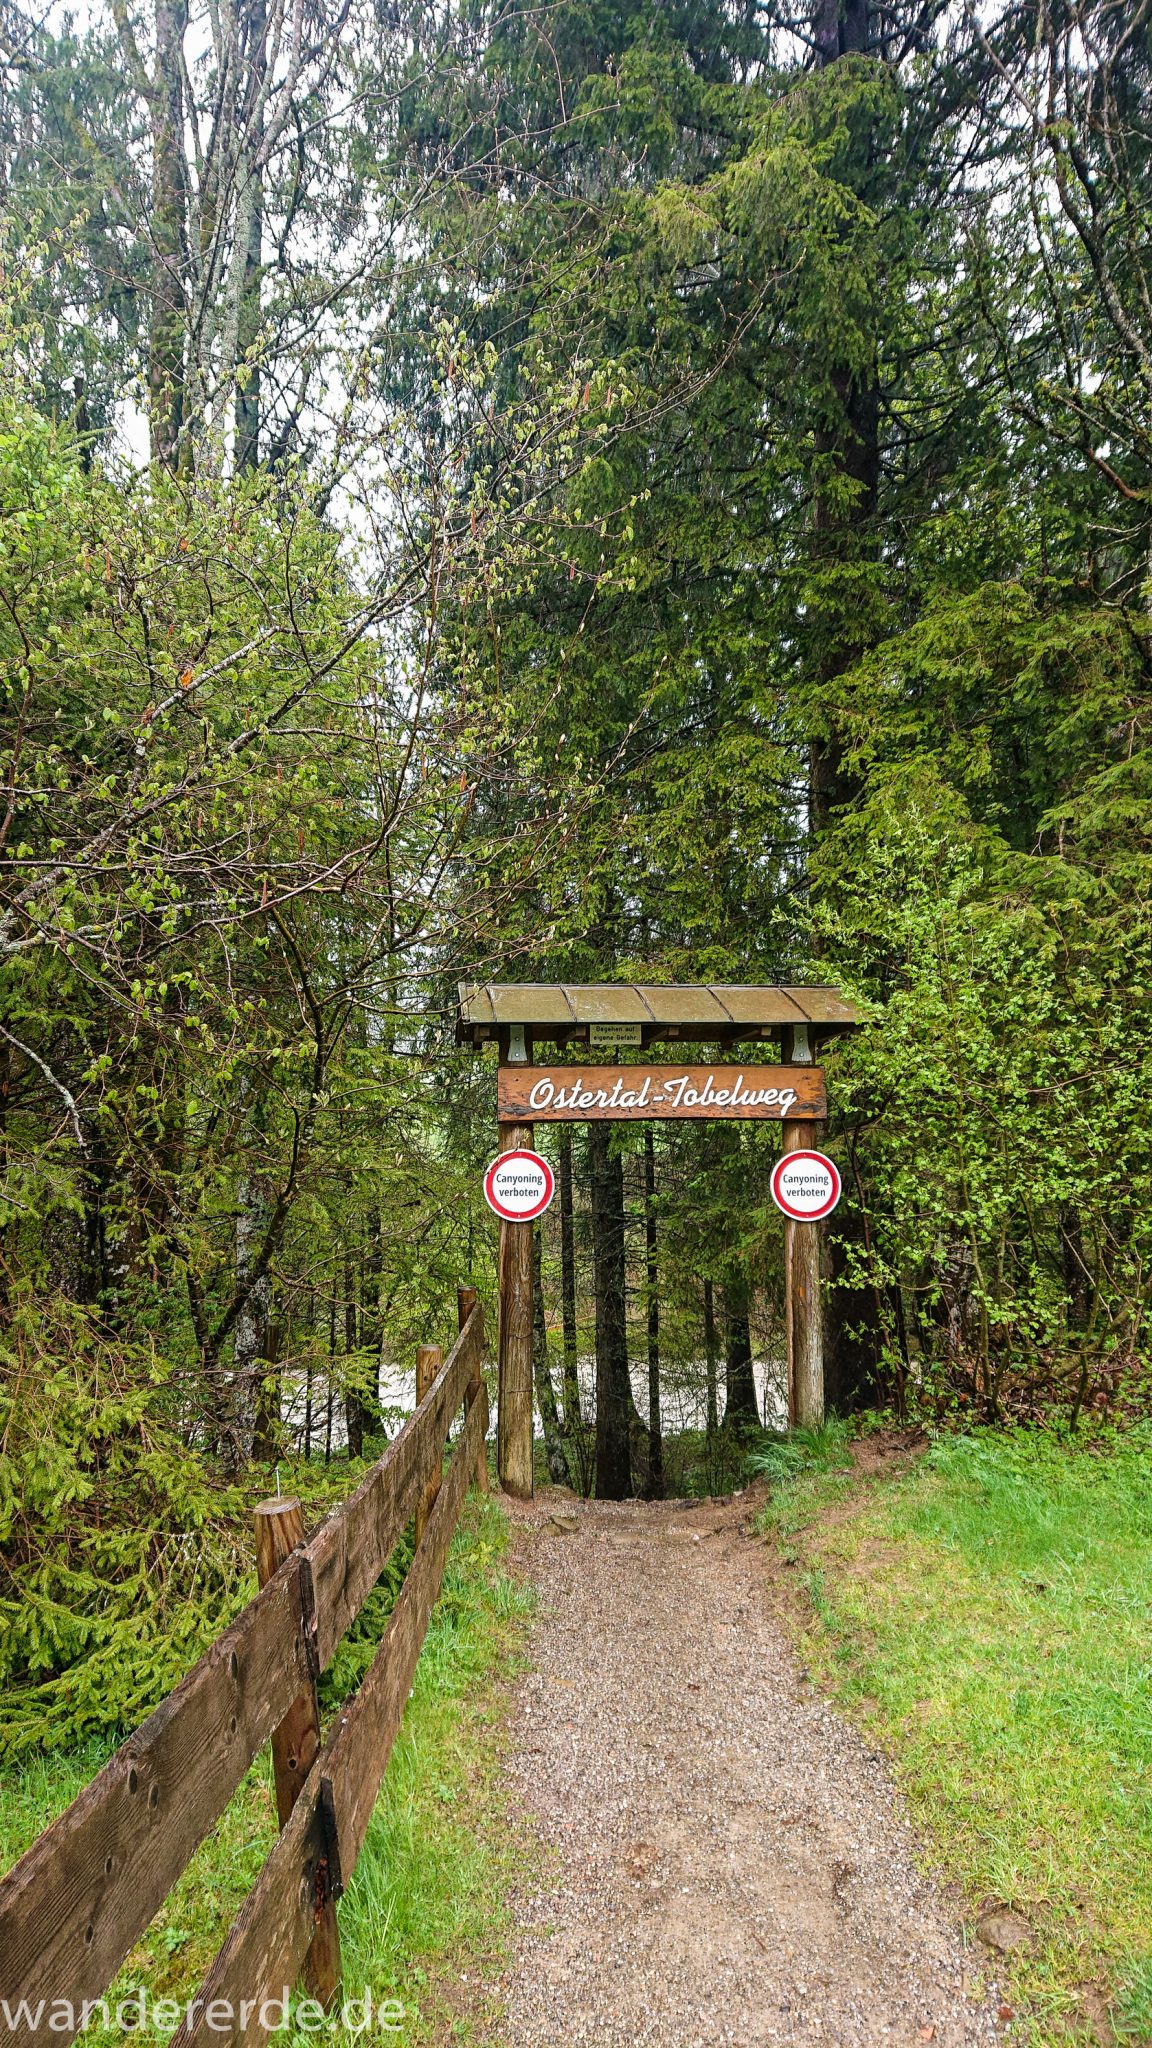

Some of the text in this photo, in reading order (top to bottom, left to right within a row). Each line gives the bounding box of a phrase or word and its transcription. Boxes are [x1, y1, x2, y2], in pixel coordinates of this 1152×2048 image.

[529, 1075, 797, 1116] Ostertal-Tobelweg
[496, 1173, 543, 1185] Canyoning
[783, 1174, 829, 1185] Canyoning
[499, 1187, 539, 1197] verboten
[786, 1187, 826, 1197] verboten
